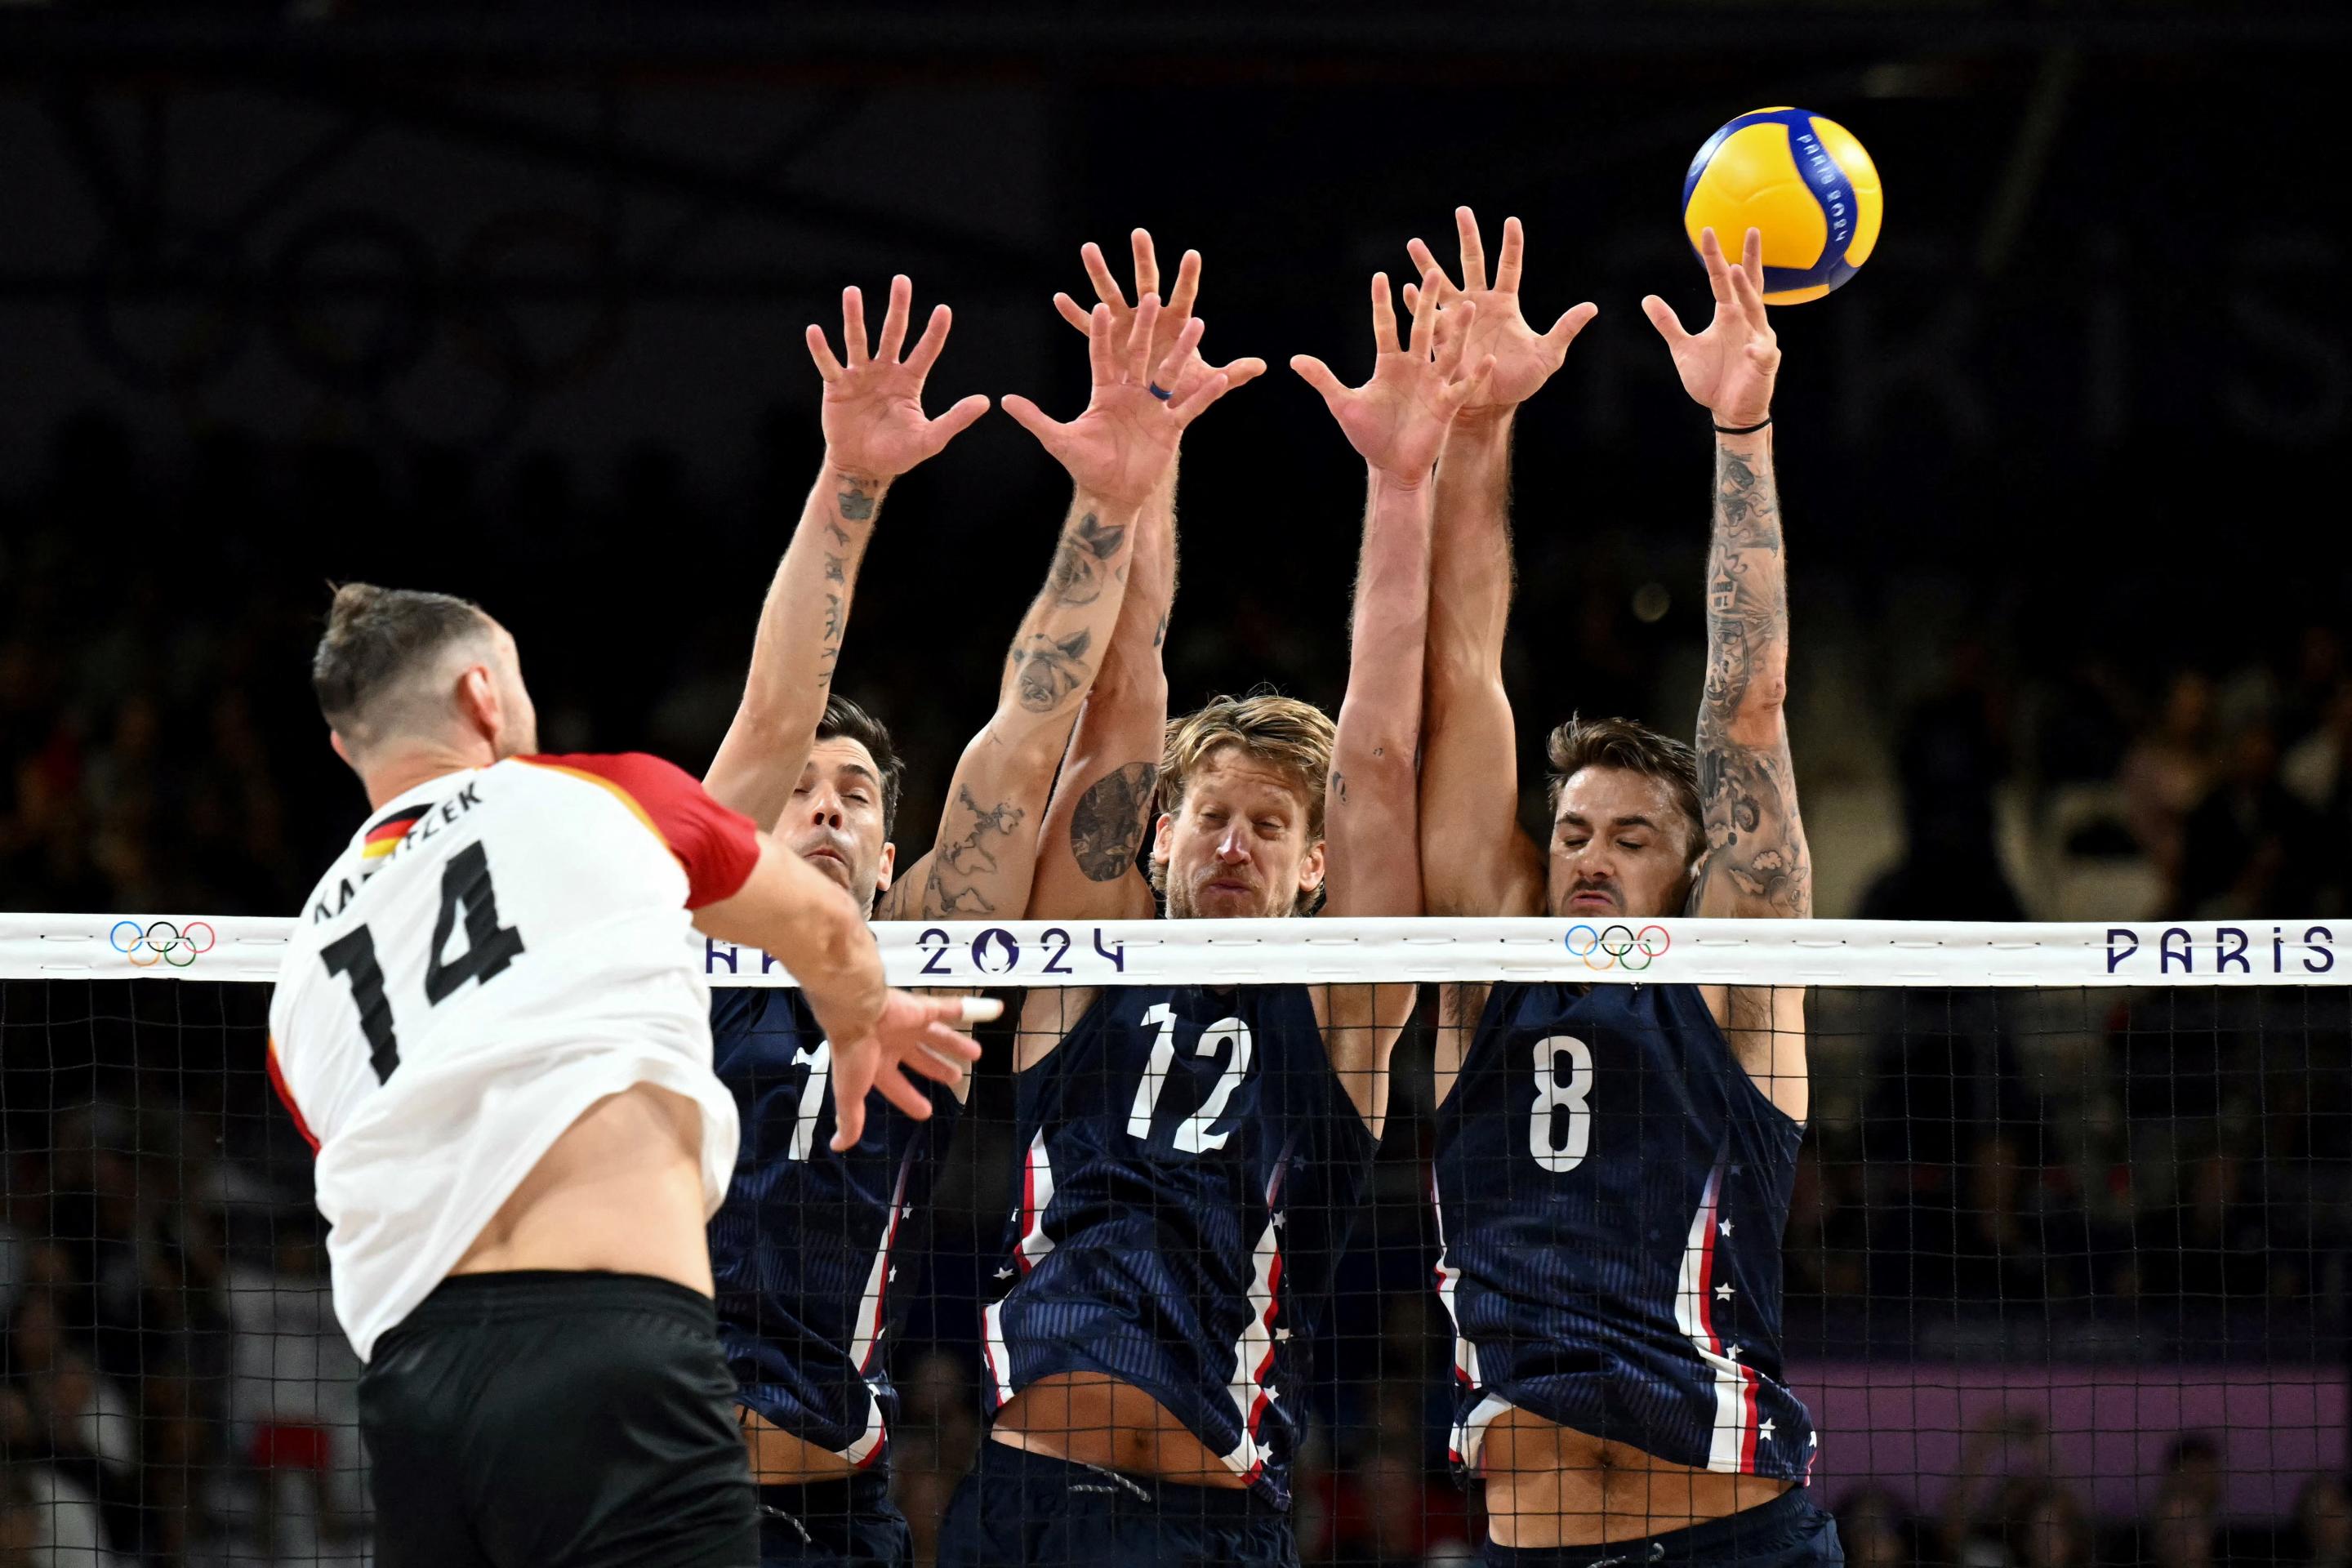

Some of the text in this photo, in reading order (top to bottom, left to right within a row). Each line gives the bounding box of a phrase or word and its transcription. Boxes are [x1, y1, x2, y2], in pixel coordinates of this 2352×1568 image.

[319, 840, 525, 1086] 14
[2107, 926, 2334, 974] PARIS
[1127, 1003, 1252, 1154] 12
[1530, 1036, 1592, 1173] 8
